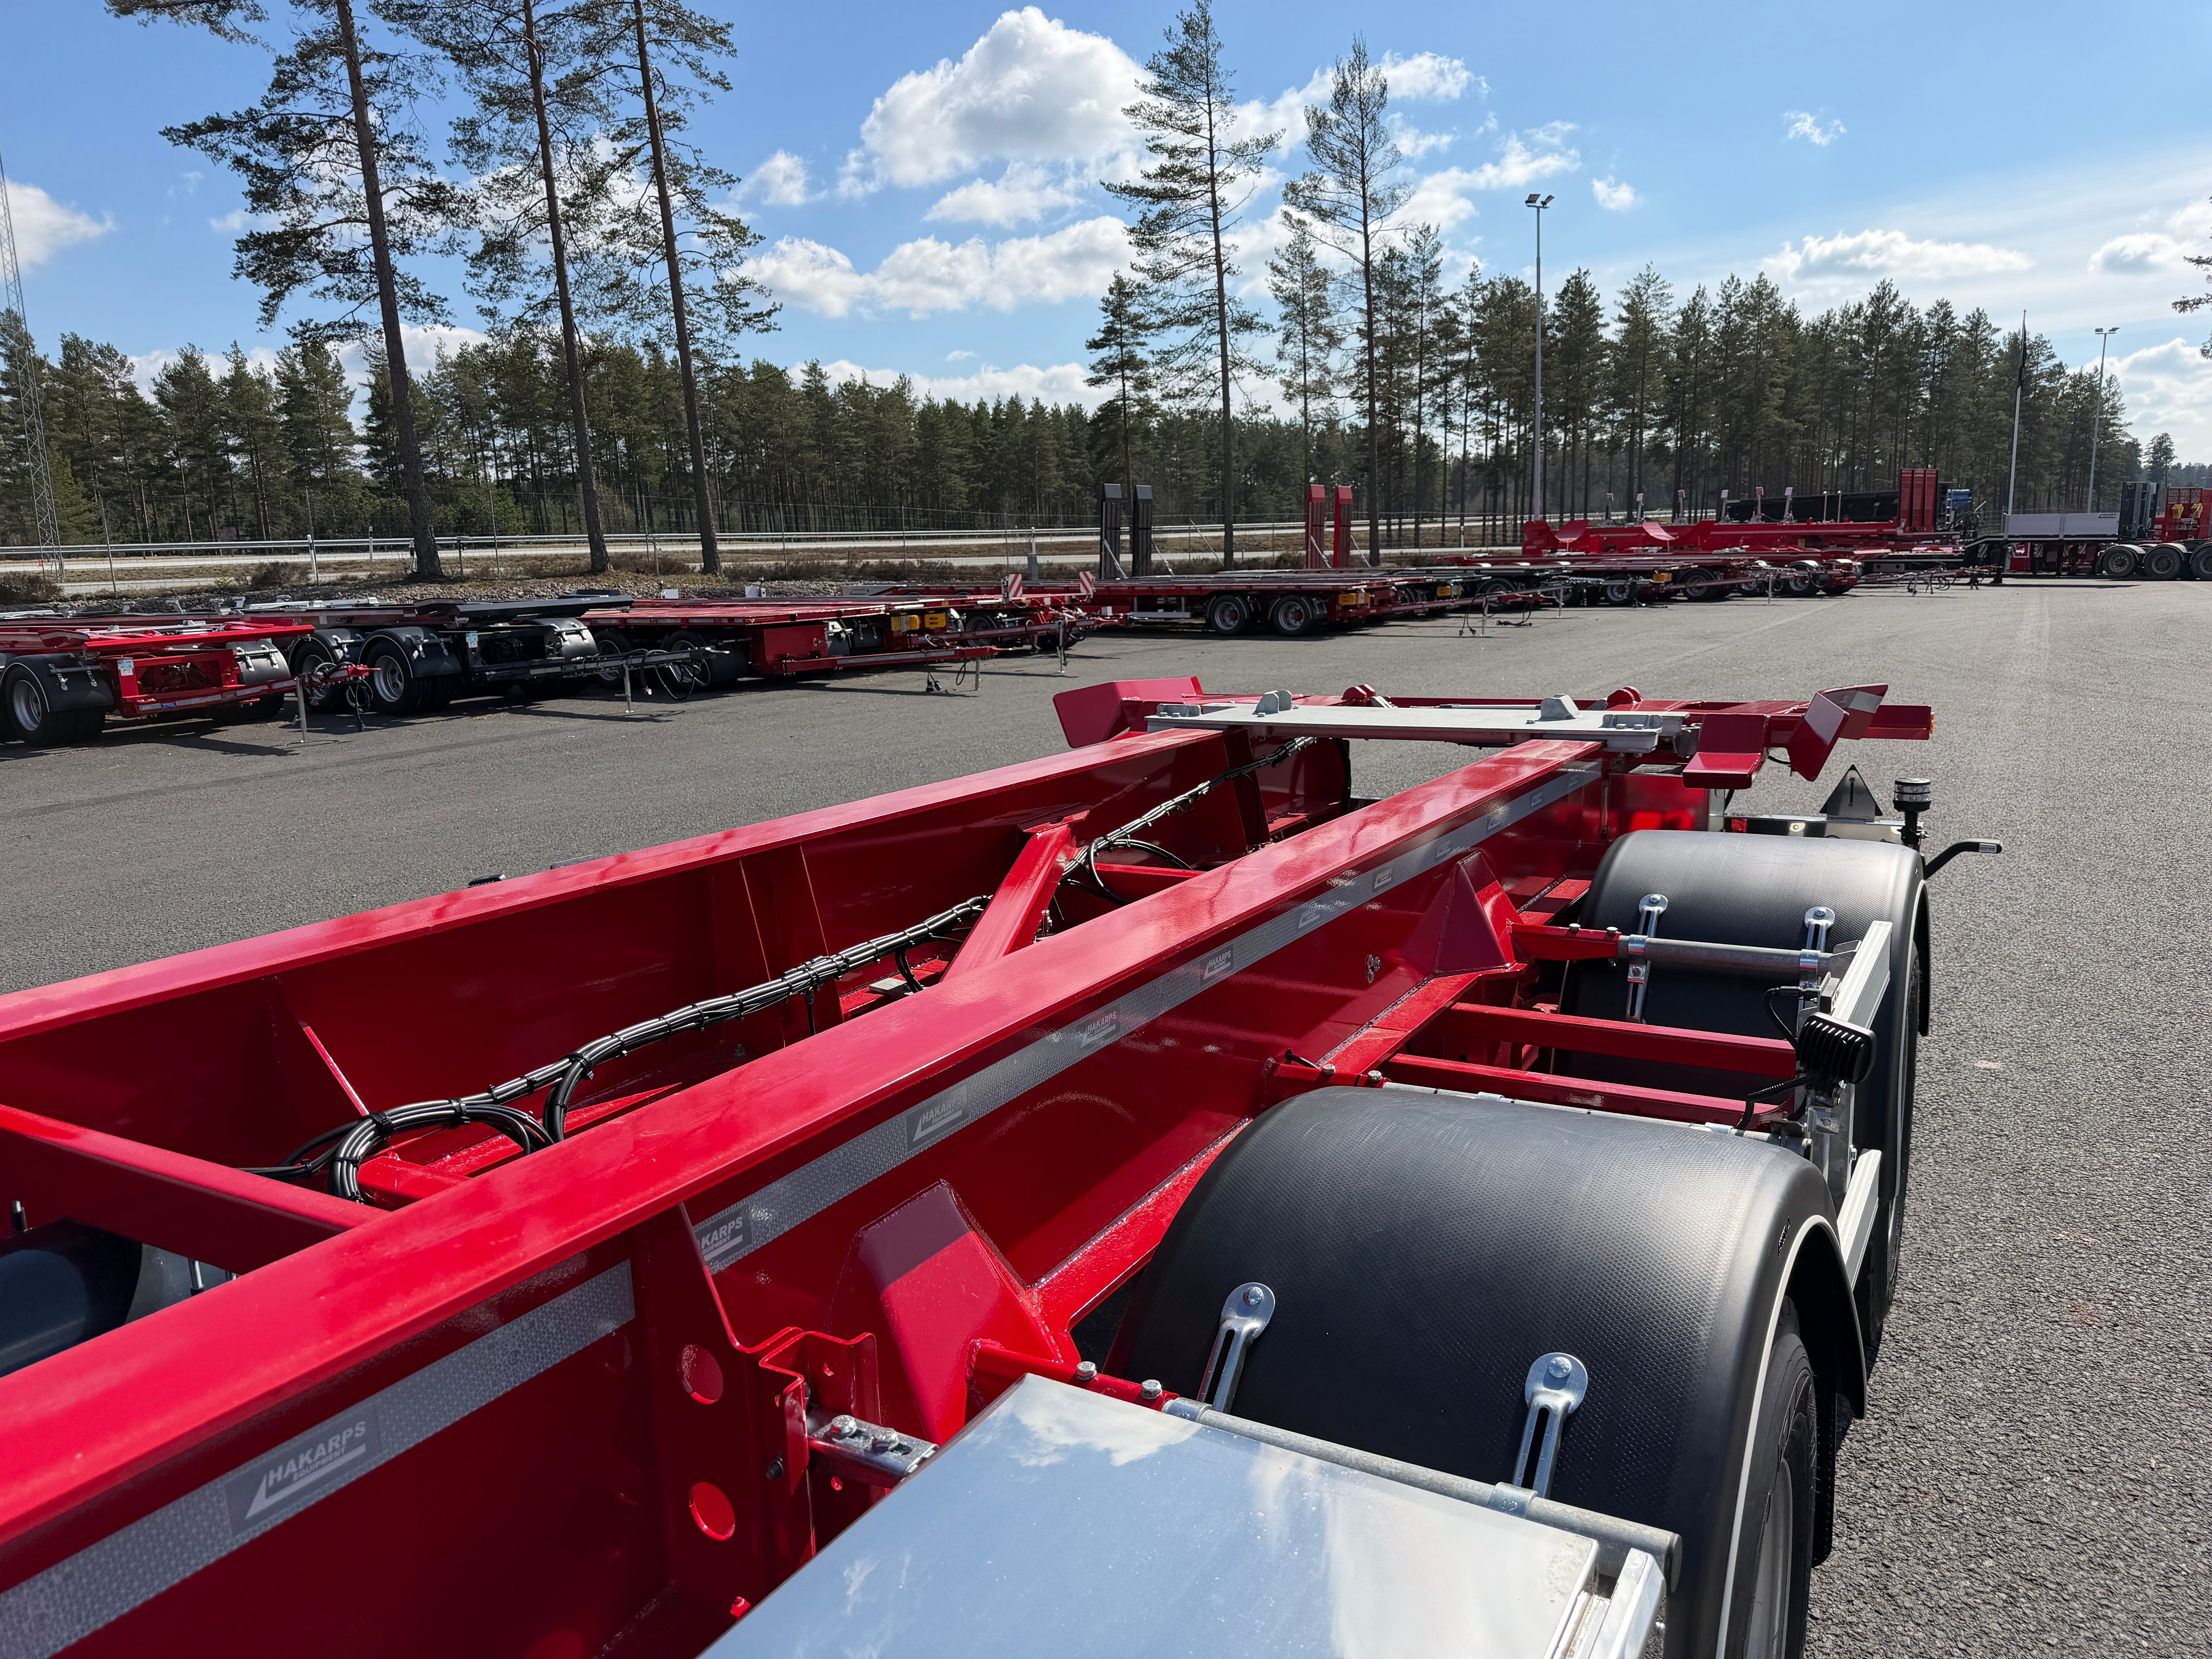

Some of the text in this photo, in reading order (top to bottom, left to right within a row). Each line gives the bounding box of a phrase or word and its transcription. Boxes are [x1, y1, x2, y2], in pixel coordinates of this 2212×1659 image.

[1208, 950, 1231, 969] HAKARPS
[1087, 1011, 1116, 1035] HAKARPS
[922, 1093, 963, 1125] HAKARPS
[701, 1216, 743, 1249] KARPS
[701, 1234, 731, 1255] QUIPMENT
[266, 1420, 366, 1487] HAKARPS
